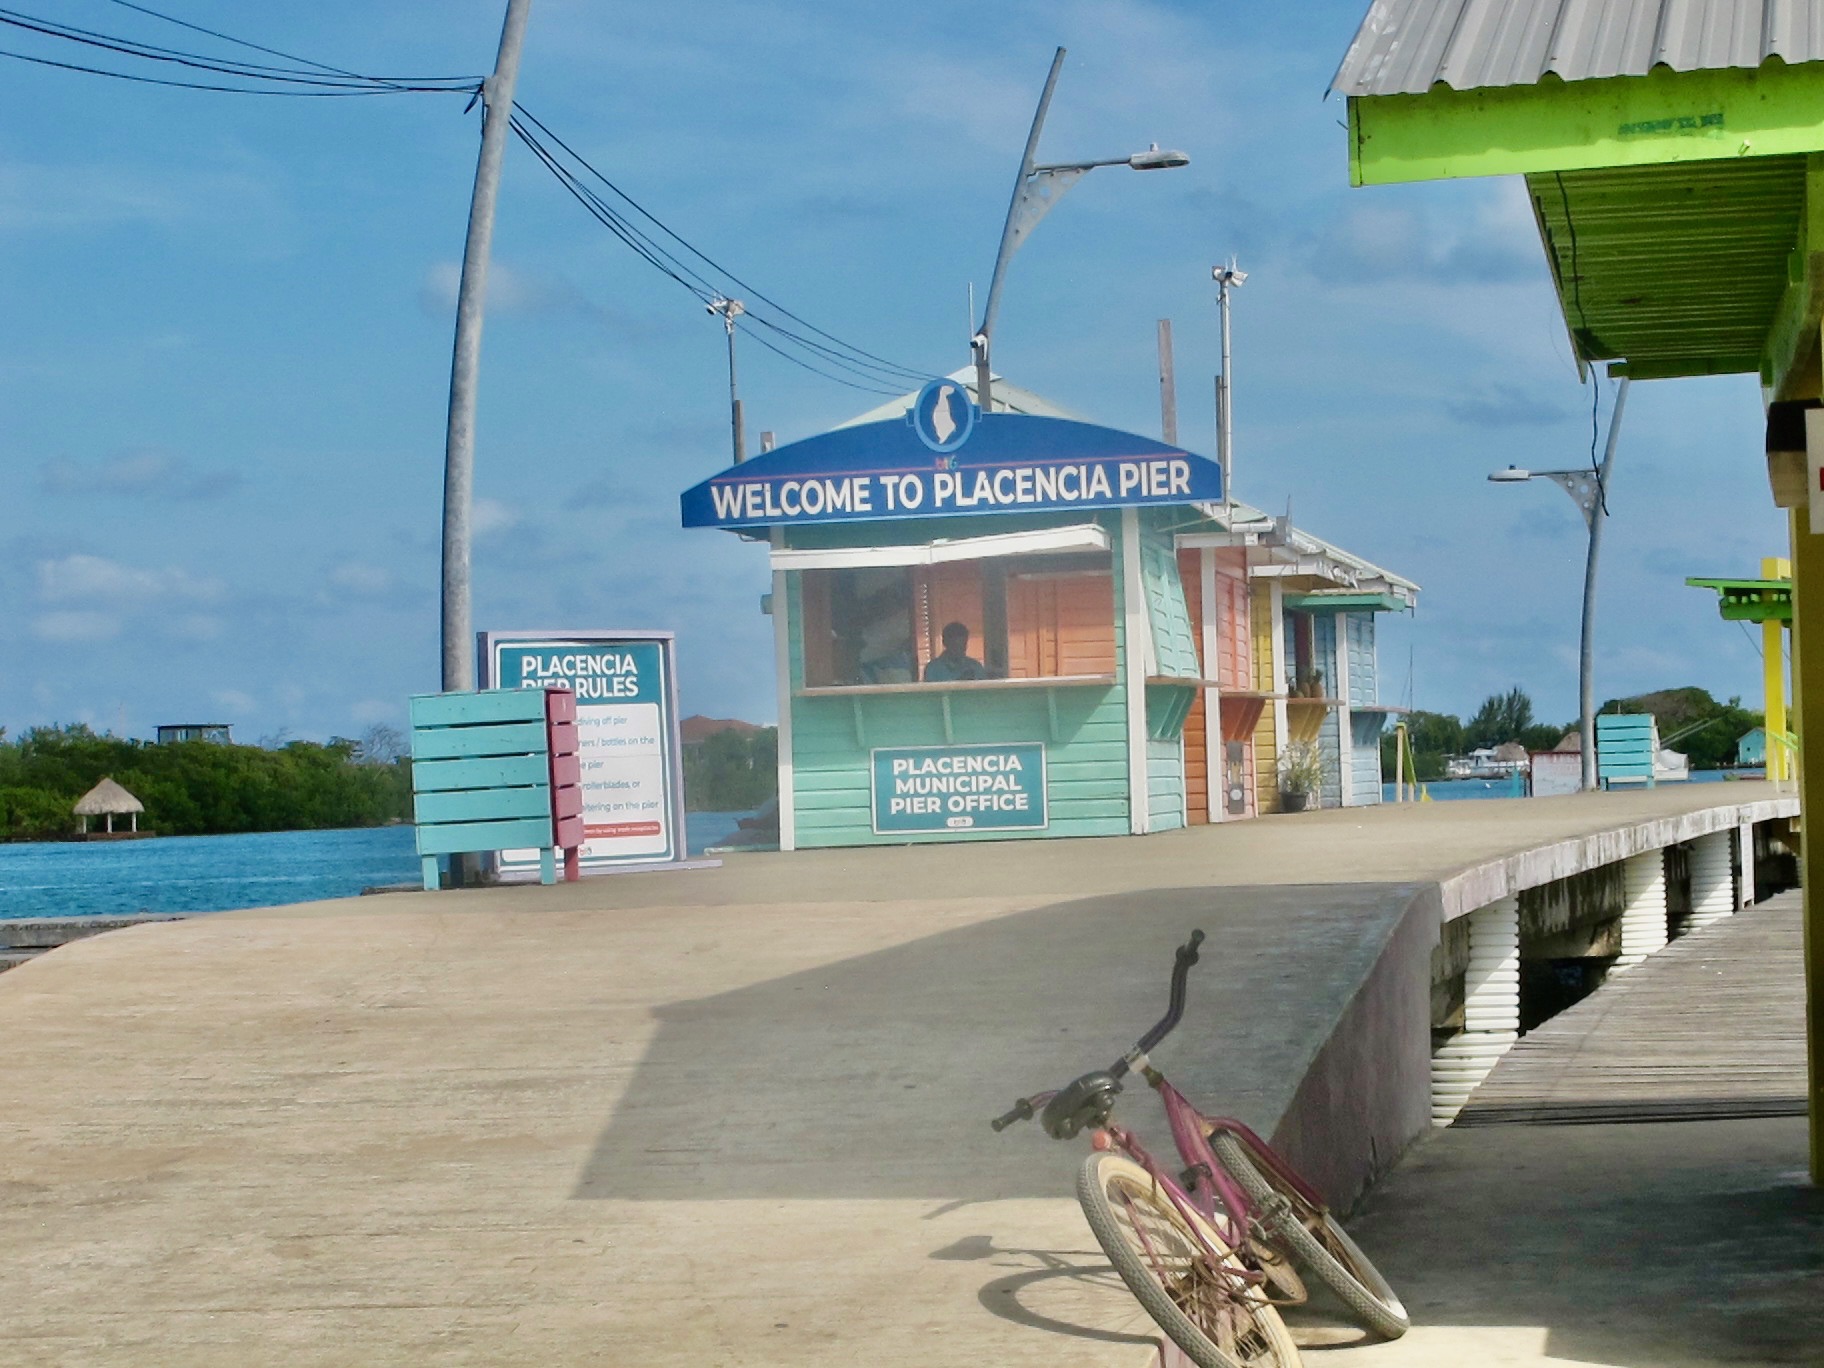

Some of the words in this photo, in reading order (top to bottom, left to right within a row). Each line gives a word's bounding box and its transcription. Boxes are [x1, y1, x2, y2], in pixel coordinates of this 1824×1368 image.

[711, 477, 873, 519] WELCOME
[880, 474, 924, 511] TO
[934, 464, 1113, 508] PLACENCIA
[1118, 460, 1191, 498] PIER
[521, 654, 638, 677] PLACENCIA
[576, 676, 639, 698] RULES
[613, 715, 628, 726] pier
[640, 735, 655, 744] the
[893, 755, 1023, 776] PLACENCIA
[895, 774, 1023, 795] MUNICIPAL
[612, 803, 624, 811] on
[890, 796, 942, 815] PIER
[947, 793, 1029, 813] OFFICE
